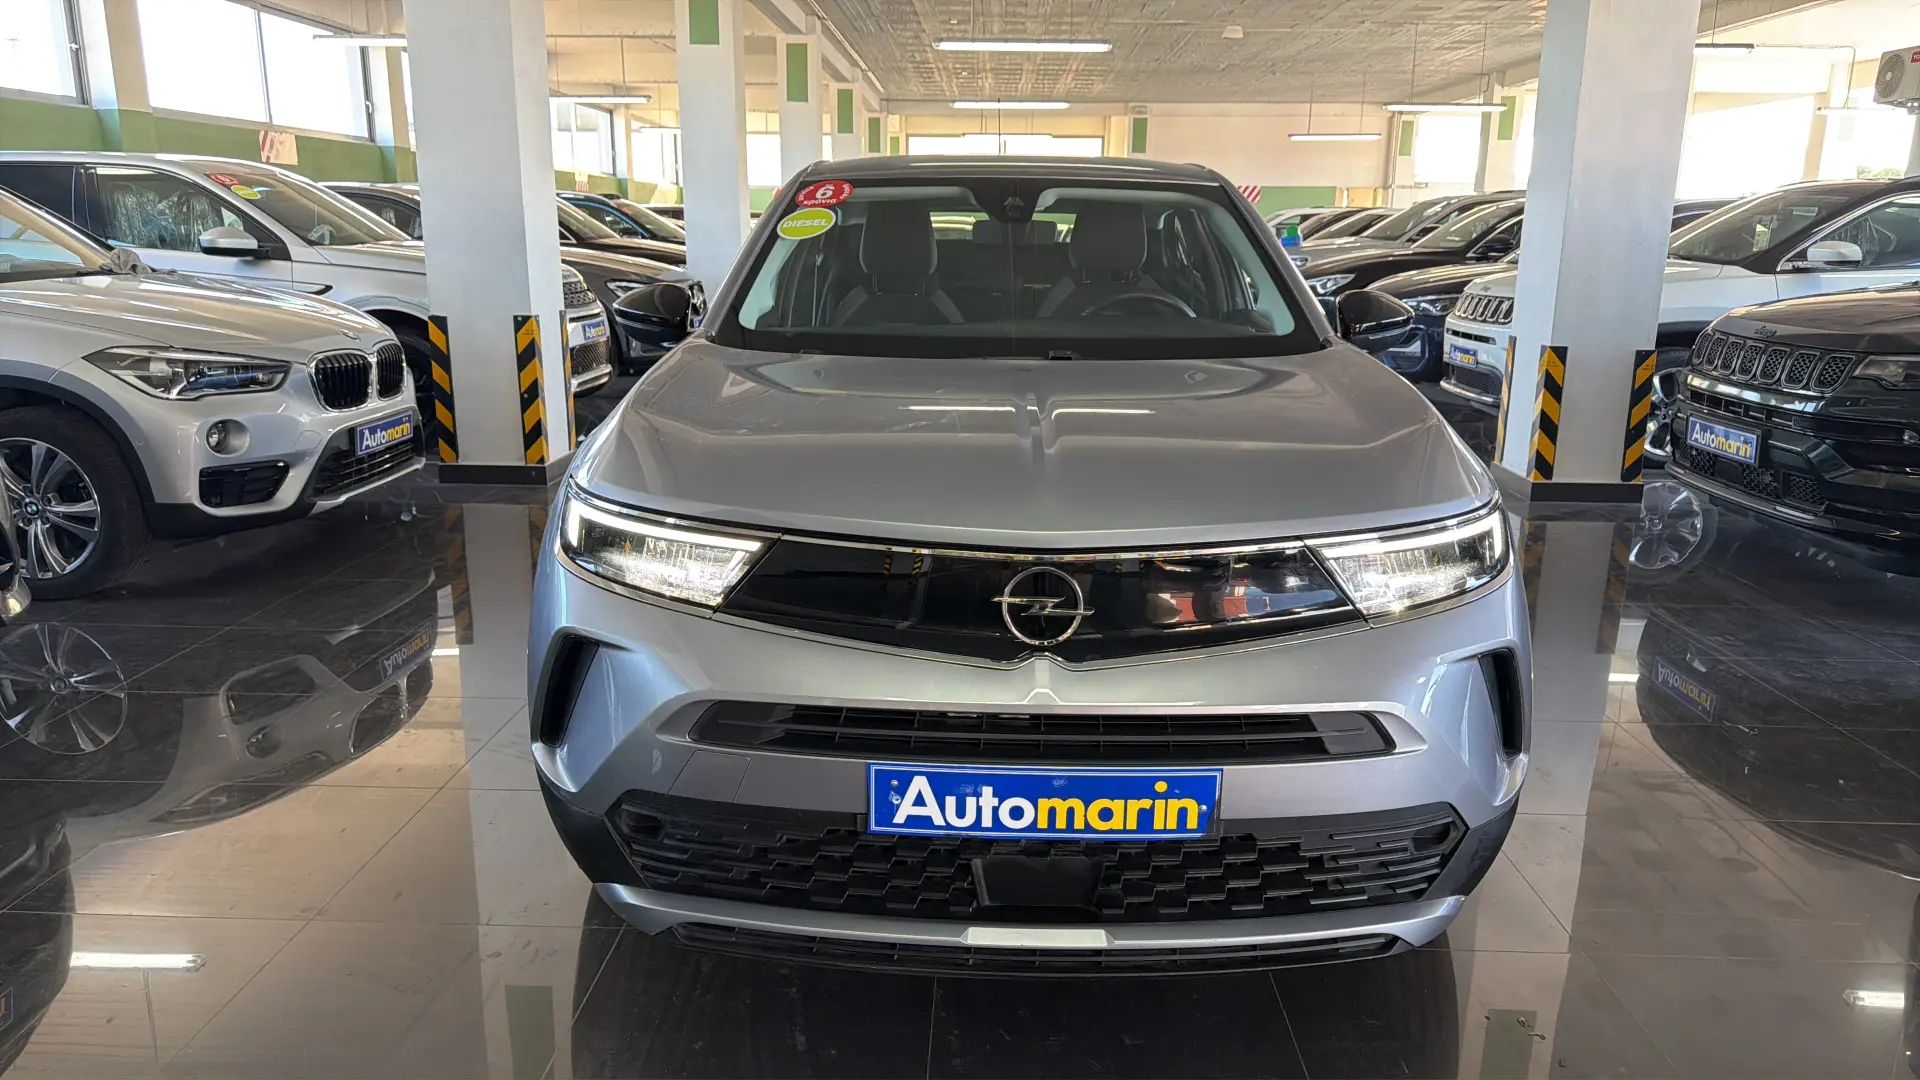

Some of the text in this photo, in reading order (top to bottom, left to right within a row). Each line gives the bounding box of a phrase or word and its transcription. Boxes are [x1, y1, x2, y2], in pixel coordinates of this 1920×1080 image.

[815, 185, 835, 199] 6
[783, 219, 828, 228] DIESEL
[361, 417, 411, 450] Automarin
[1692, 422, 1751, 458] Automarin
[892, 775, 1199, 830] Automarin
